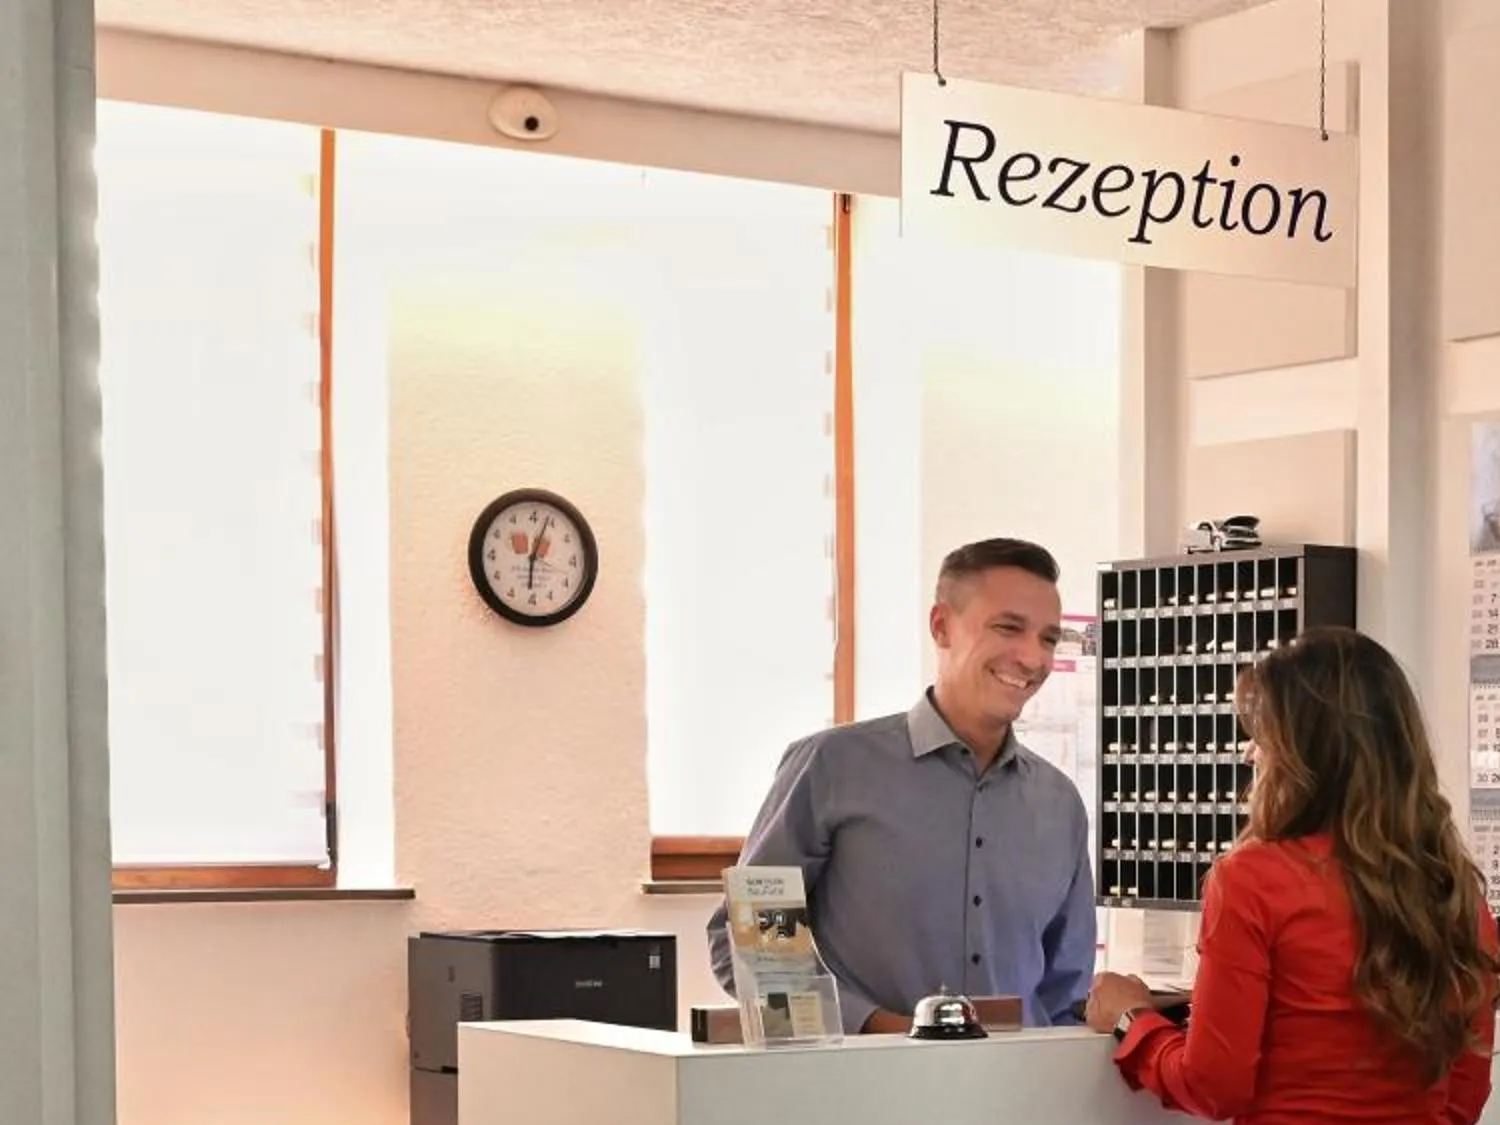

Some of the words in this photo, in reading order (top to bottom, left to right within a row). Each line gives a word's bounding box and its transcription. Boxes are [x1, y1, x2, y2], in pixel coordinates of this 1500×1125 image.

[930, 119, 1333, 245] Rezeption
[1488, 607, 1499, 617] 14
[1487, 623, 1499, 634] 21
[1485, 638, 1499, 649] 28
